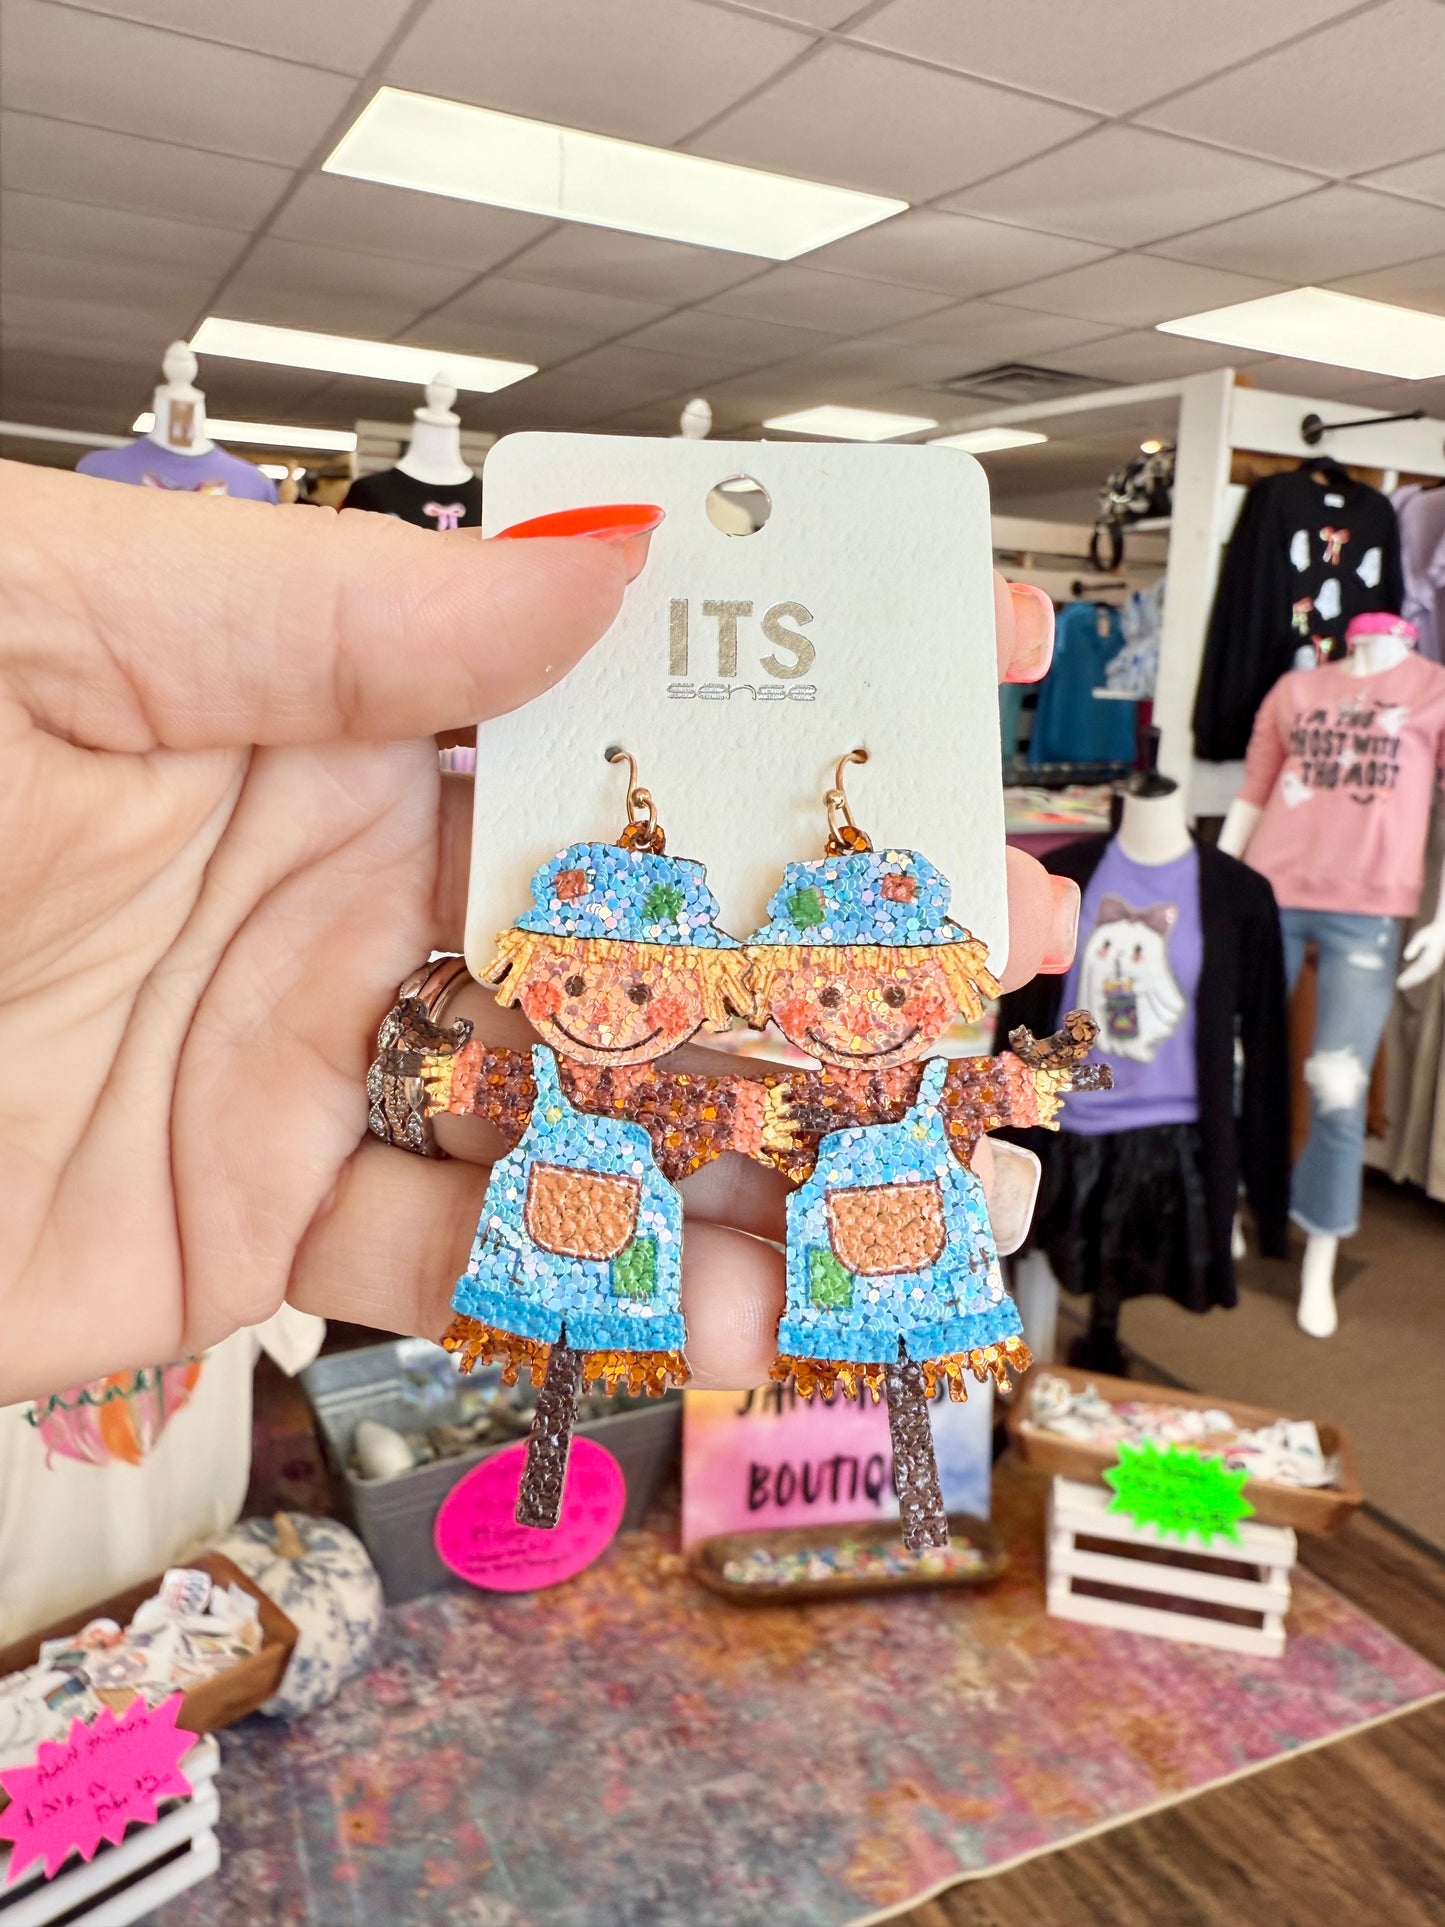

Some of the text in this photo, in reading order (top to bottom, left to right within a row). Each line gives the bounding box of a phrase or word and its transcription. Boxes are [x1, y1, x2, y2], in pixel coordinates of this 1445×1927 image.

[669, 598, 817, 679] ITS
[667, 682, 817, 701] sense
[747, 1453, 902, 1511] BOUTIQ
